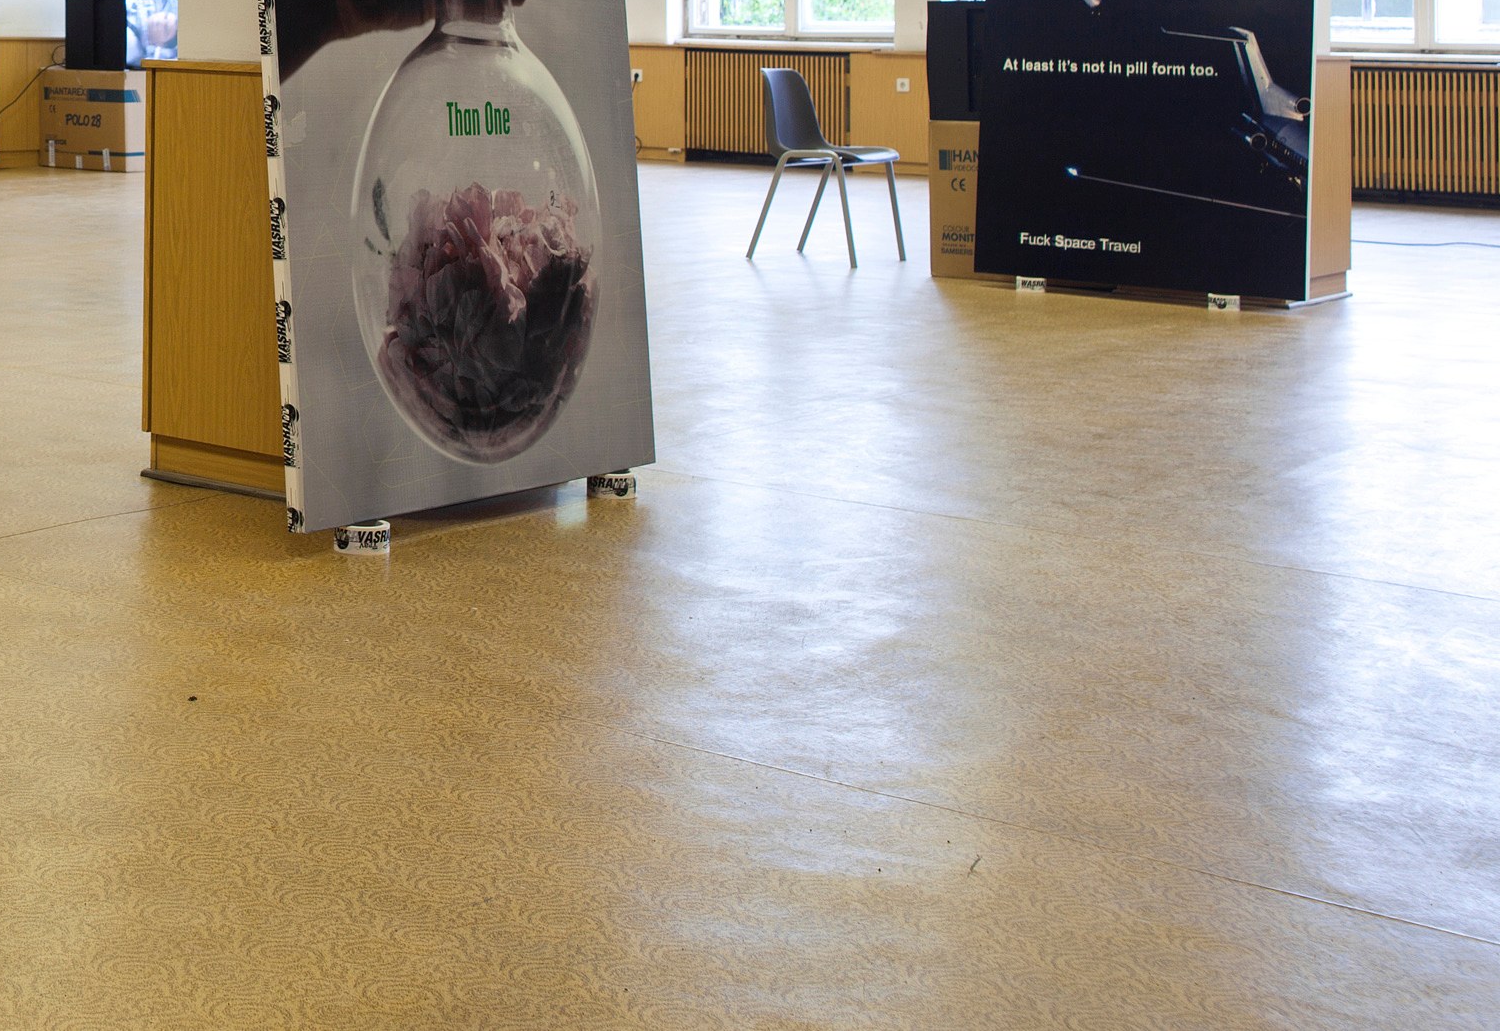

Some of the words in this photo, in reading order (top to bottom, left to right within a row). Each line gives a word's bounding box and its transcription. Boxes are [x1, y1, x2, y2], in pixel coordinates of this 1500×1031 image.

[1003, 58, 1018, 71] At
[1022, 58, 1054, 72] least
[1058, 59, 1078, 73] it's
[1082, 61, 1105, 74] not
[1109, 61, 1121, 74] in
[1126, 61, 1148, 77] pill
[1152, 61, 1186, 76] form
[1190, 63, 1219, 77] too.
[65, 113, 89, 126] POLO
[91, 114, 101, 128] 28
[446, 101, 480, 136] Than
[485, 101, 510, 135] One
[951, 178, 966, 192] CE
[1019, 232, 1050, 246] Fuck
[1054, 234, 1096, 250] Space
[1099, 238, 1141, 253] Travel
